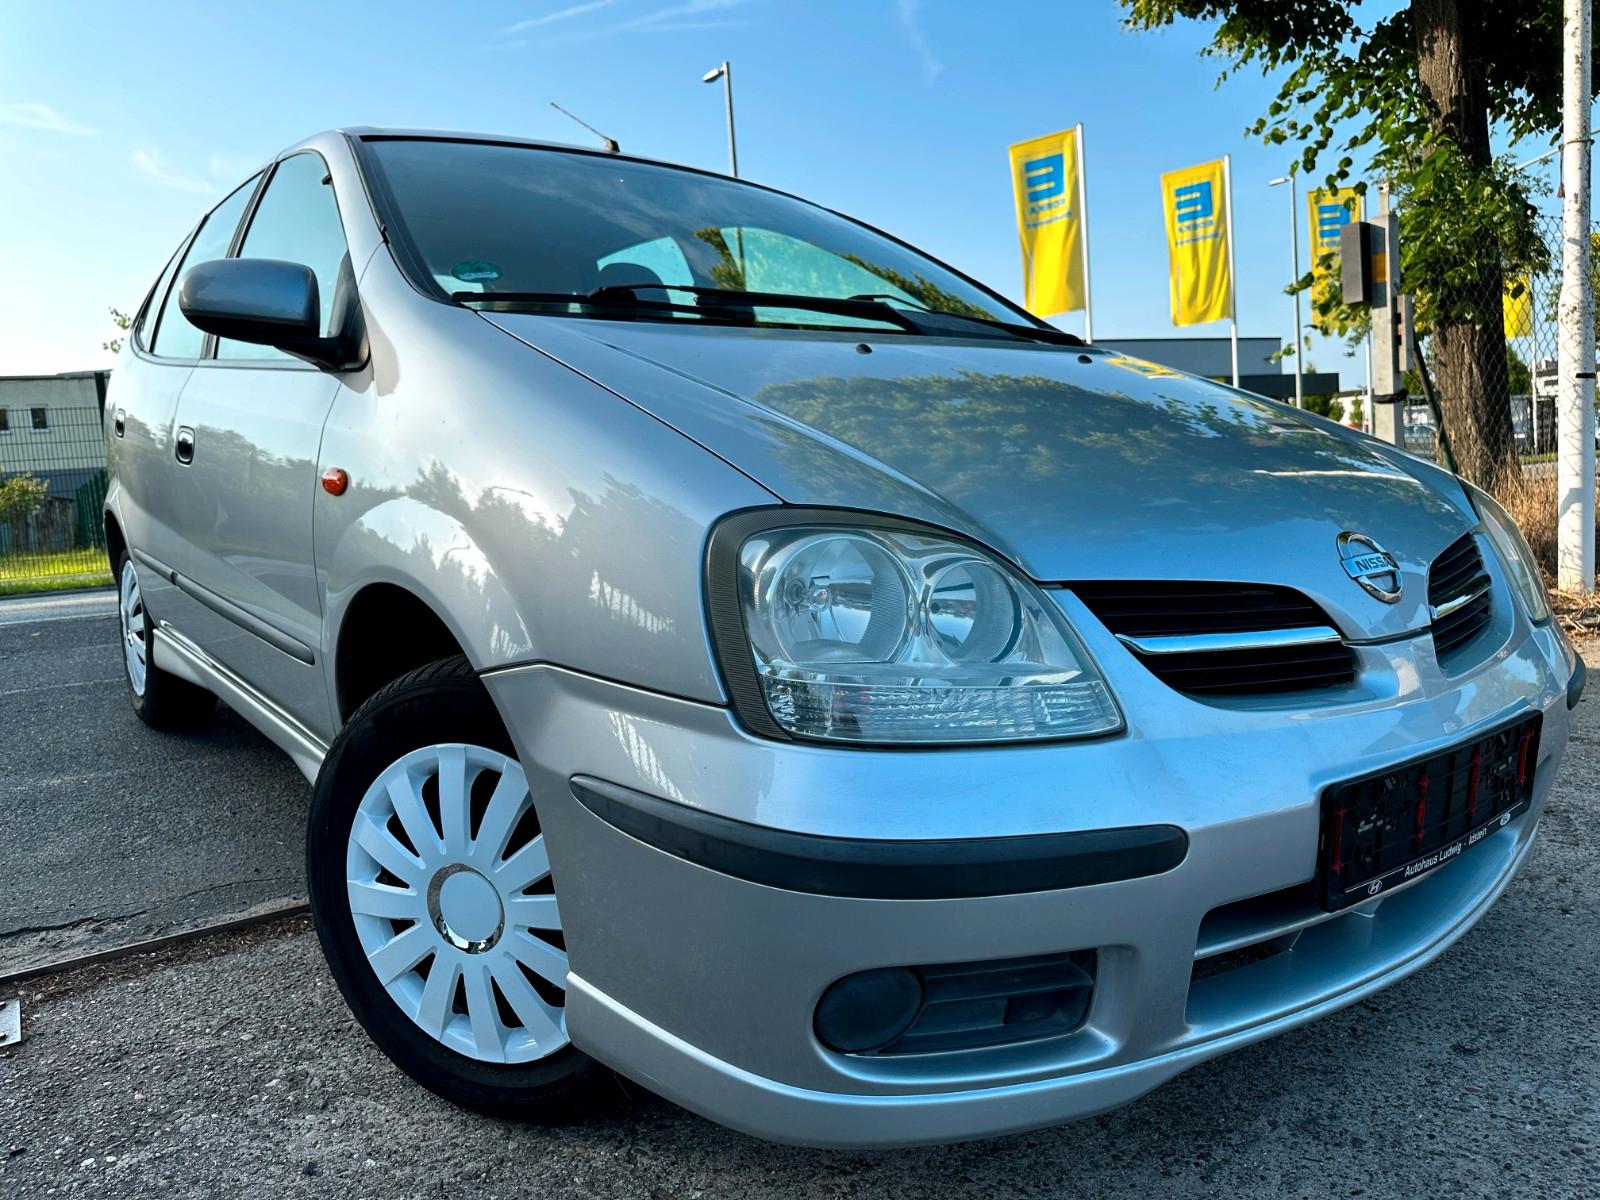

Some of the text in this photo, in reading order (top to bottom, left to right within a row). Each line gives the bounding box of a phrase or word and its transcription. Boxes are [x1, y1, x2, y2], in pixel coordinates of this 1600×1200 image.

[1404, 855, 1439, 877] Autohaus
[1439, 842, 1462, 862] Ludwig
[1468, 827, 1488, 845] Idstein
